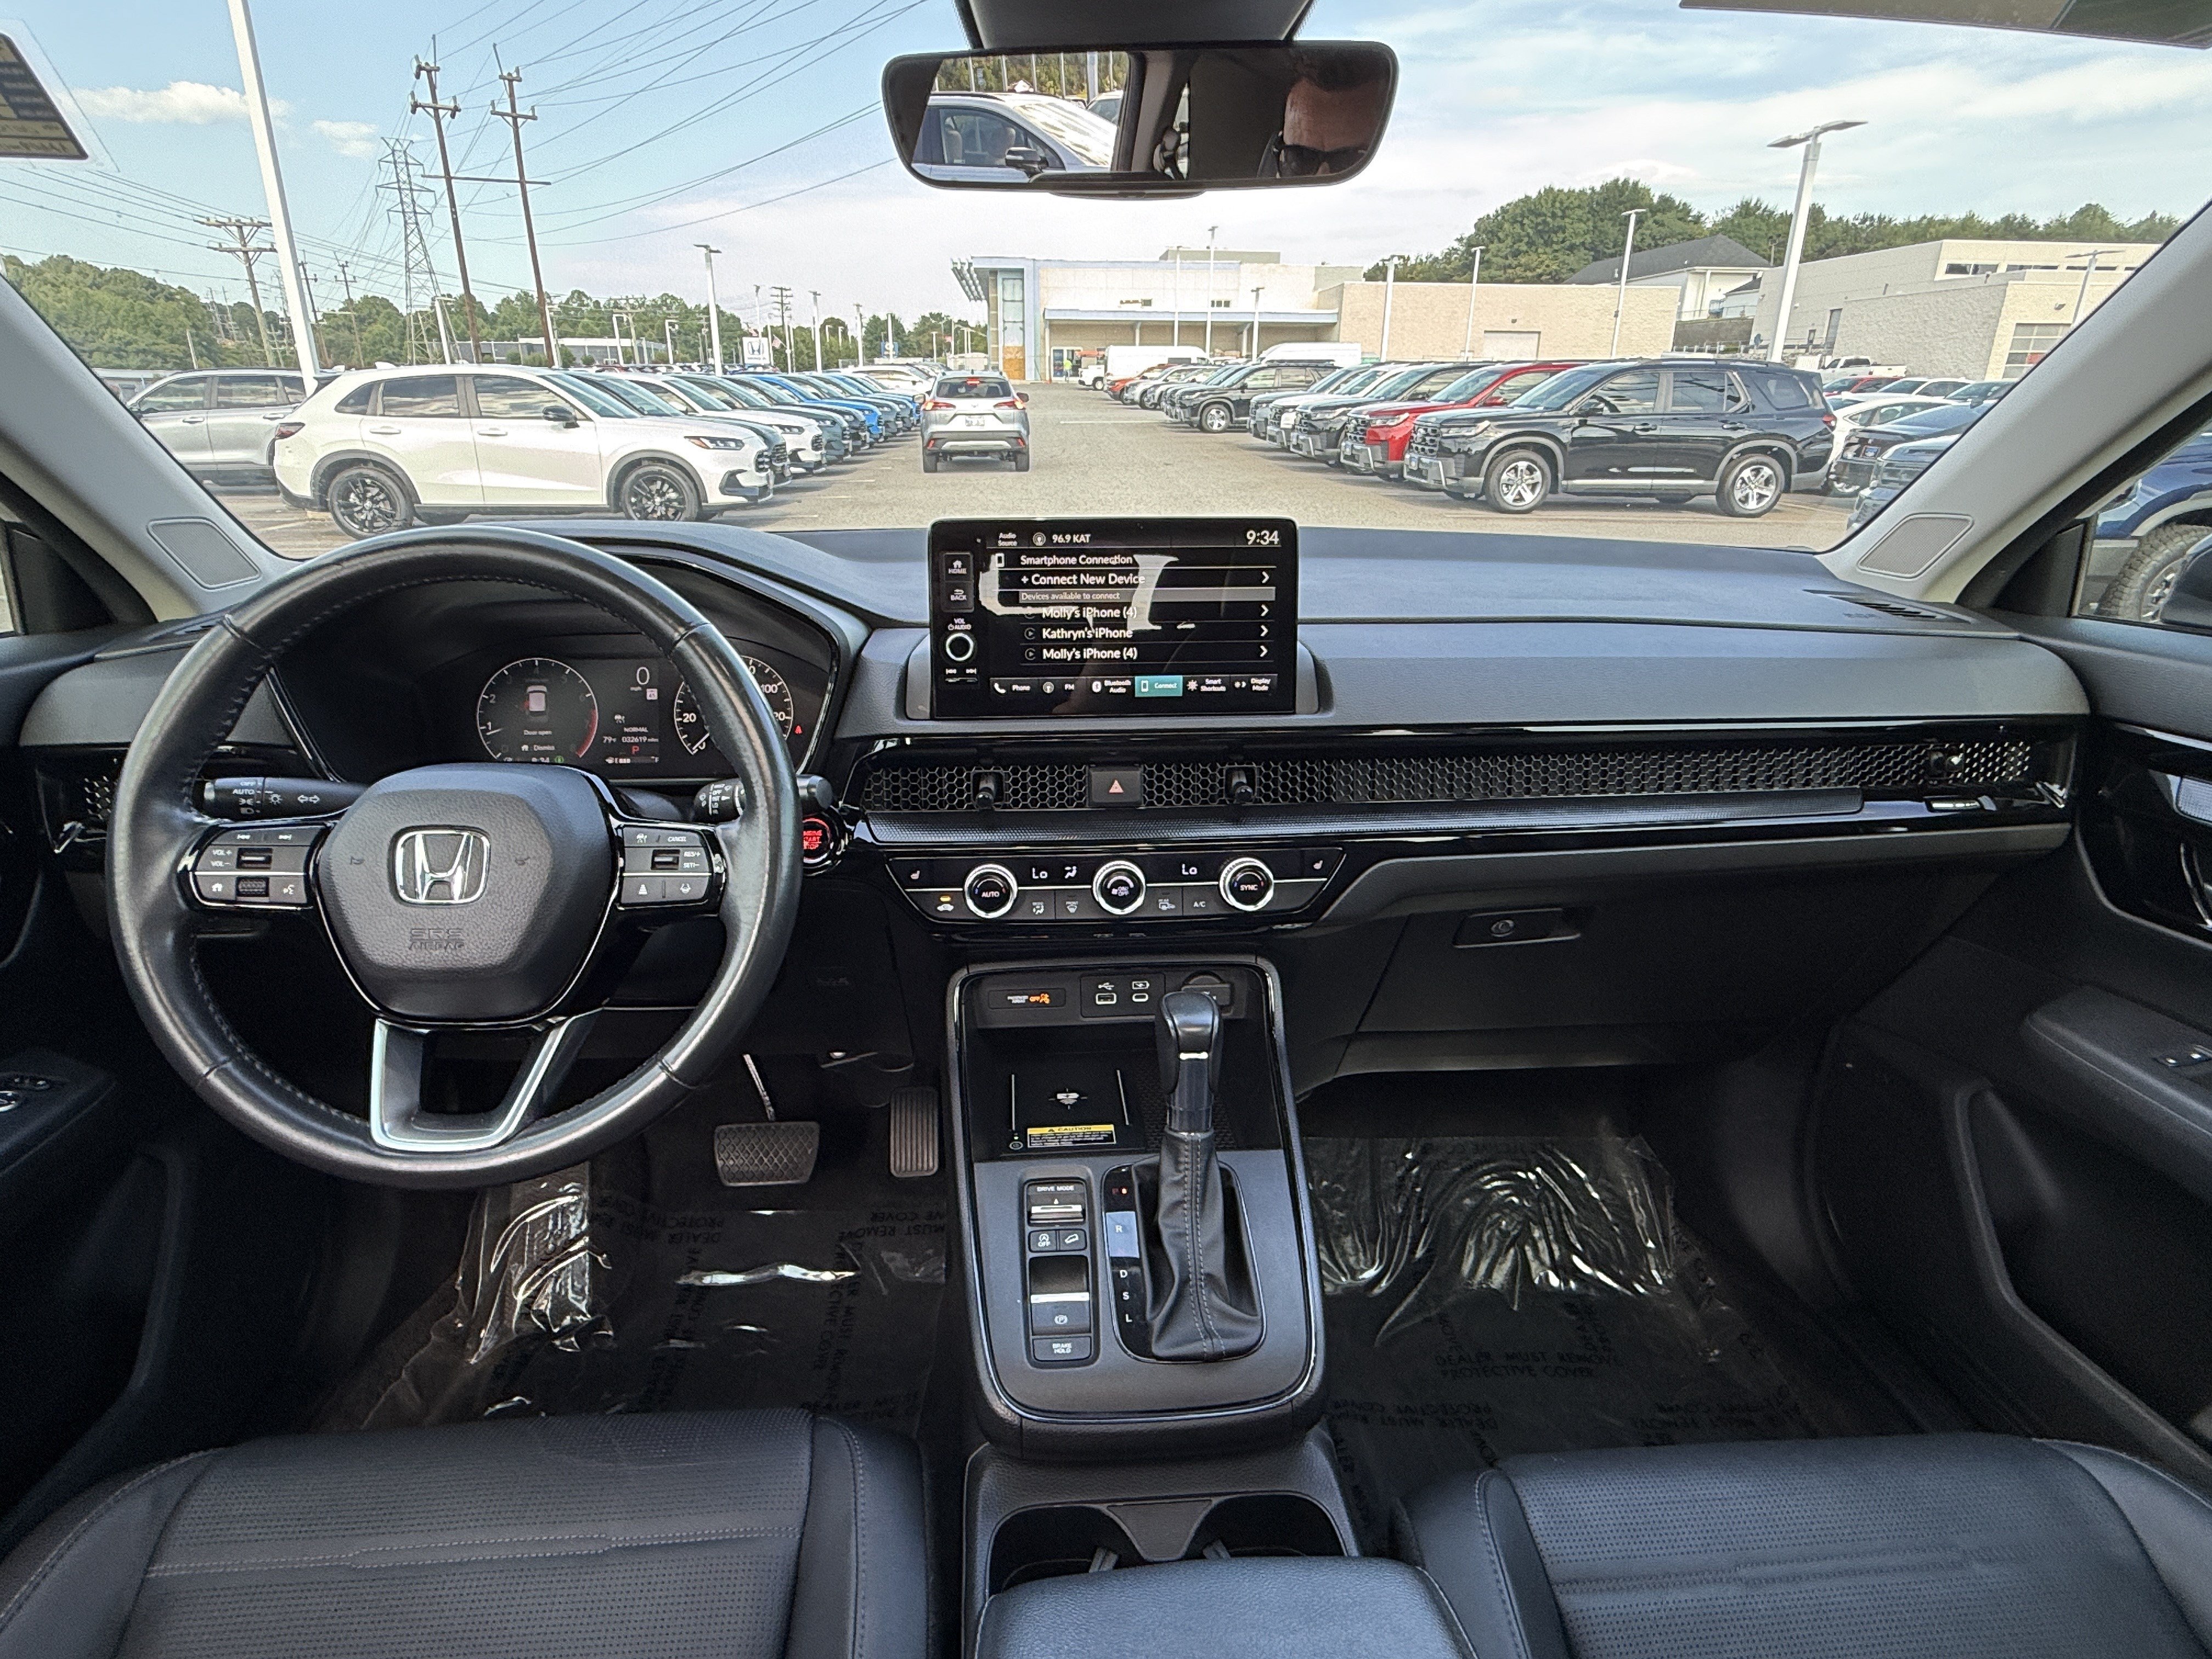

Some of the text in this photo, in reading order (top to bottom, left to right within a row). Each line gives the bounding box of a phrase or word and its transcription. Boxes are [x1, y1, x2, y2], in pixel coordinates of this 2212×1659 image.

[1052, 534, 1091, 544] 96.9 KAT
[1246, 530, 1279, 545] 9:34
[1020, 554, 1132, 567] Smartphone Connection
[1031, 574, 1077, 585] Connect
[1080, 574, 1105, 585] New
[1108, 573, 1146, 584] Device
[1022, 592, 1049, 600] Devices
[1051, 591, 1081, 600] available
[1092, 591, 1120, 600] connect
[1042, 606, 1137, 620] Molly's iPhone (4)
[1042, 628, 1133, 640] Kathryn's iPhone
[1042, 647, 1138, 661] Molly's iPhone (4)
[636, 667, 650, 685] 0
[761, 684, 778, 693] 100
[489, 694, 496, 703] 2
[682, 713, 697, 723] 20
[487, 721, 492, 730] 1
[632, 746, 640, 754] P
[1032, 867, 1048, 879] Lo
[1182, 864, 1197, 875] Lo
[410, 928, 464, 939] SRS
[409, 941, 465, 951] AIRBAG
[1115, 1225, 1122, 1233] R
[1120, 1270, 1128, 1278] D
[1122, 1292, 1130, 1300] S
[1126, 1314, 1132, 1322] L
